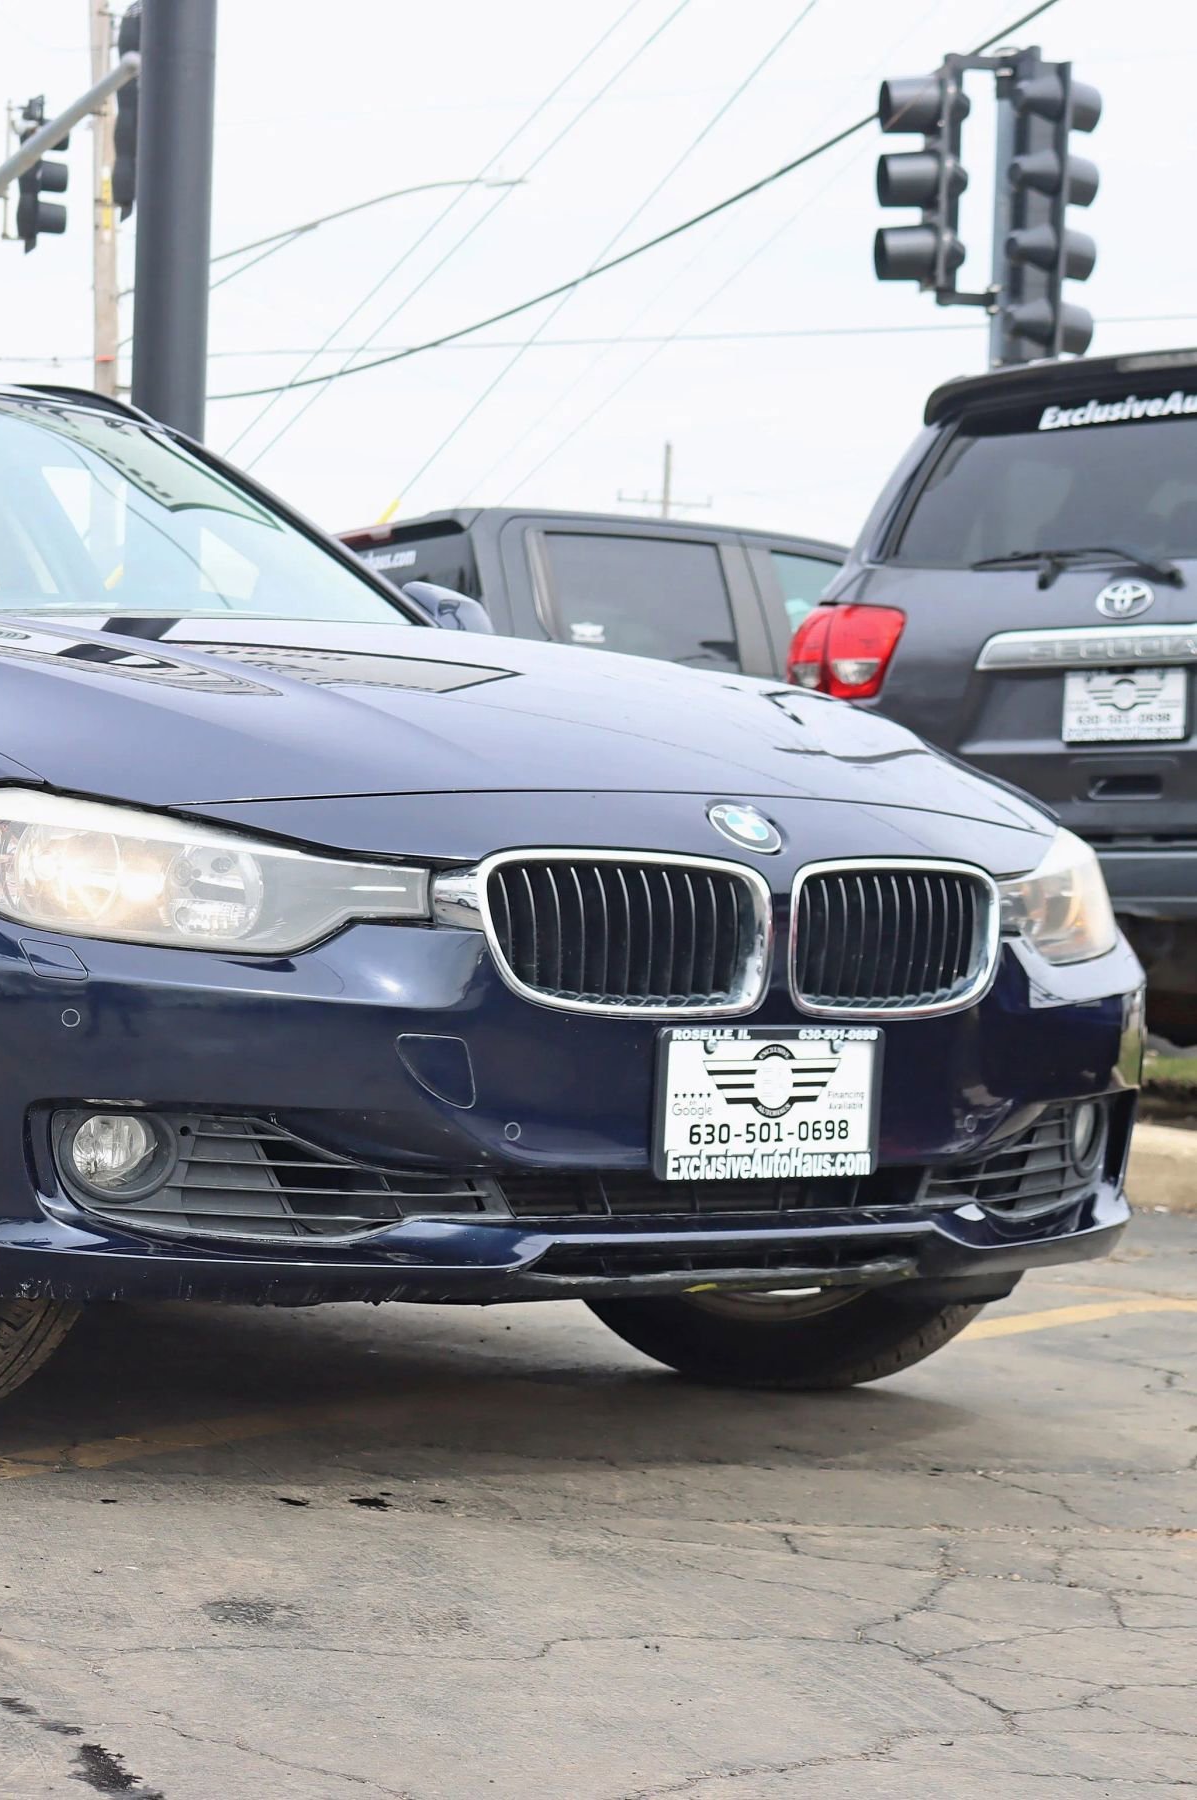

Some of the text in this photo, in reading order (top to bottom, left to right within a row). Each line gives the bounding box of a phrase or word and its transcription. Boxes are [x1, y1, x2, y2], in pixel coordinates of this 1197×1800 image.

[672, 1029, 752, 1041] ROSELLE, IL
[672, 1102, 713, 1120] Google
[688, 1119, 850, 1145] 630-501-0698
[666, 1148, 872, 1181] ExclusiveAutoHaus.com
